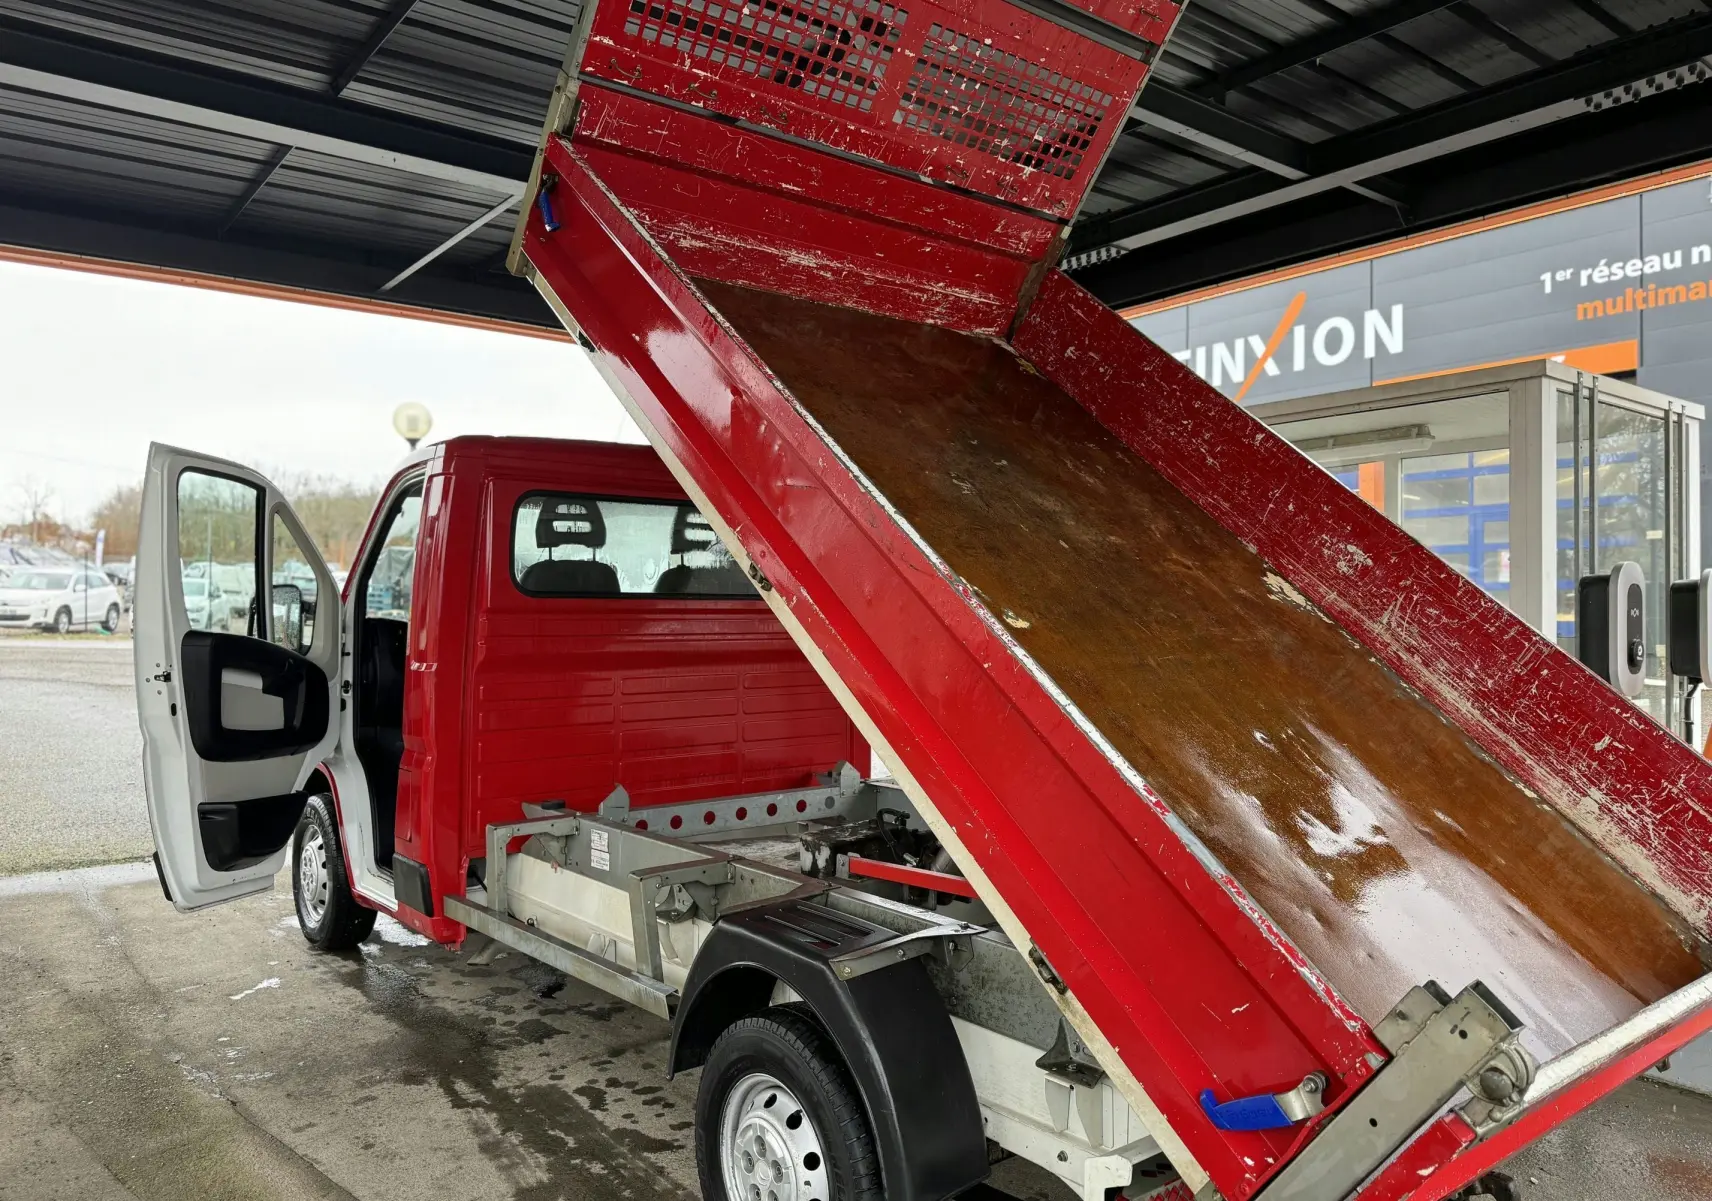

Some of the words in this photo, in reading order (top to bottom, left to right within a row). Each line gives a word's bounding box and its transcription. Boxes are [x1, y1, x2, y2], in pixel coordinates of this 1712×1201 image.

[1540, 268, 1574, 294] 1er
[1580, 249, 1682, 287] réseau
[1172, 291, 1404, 401] INXION
